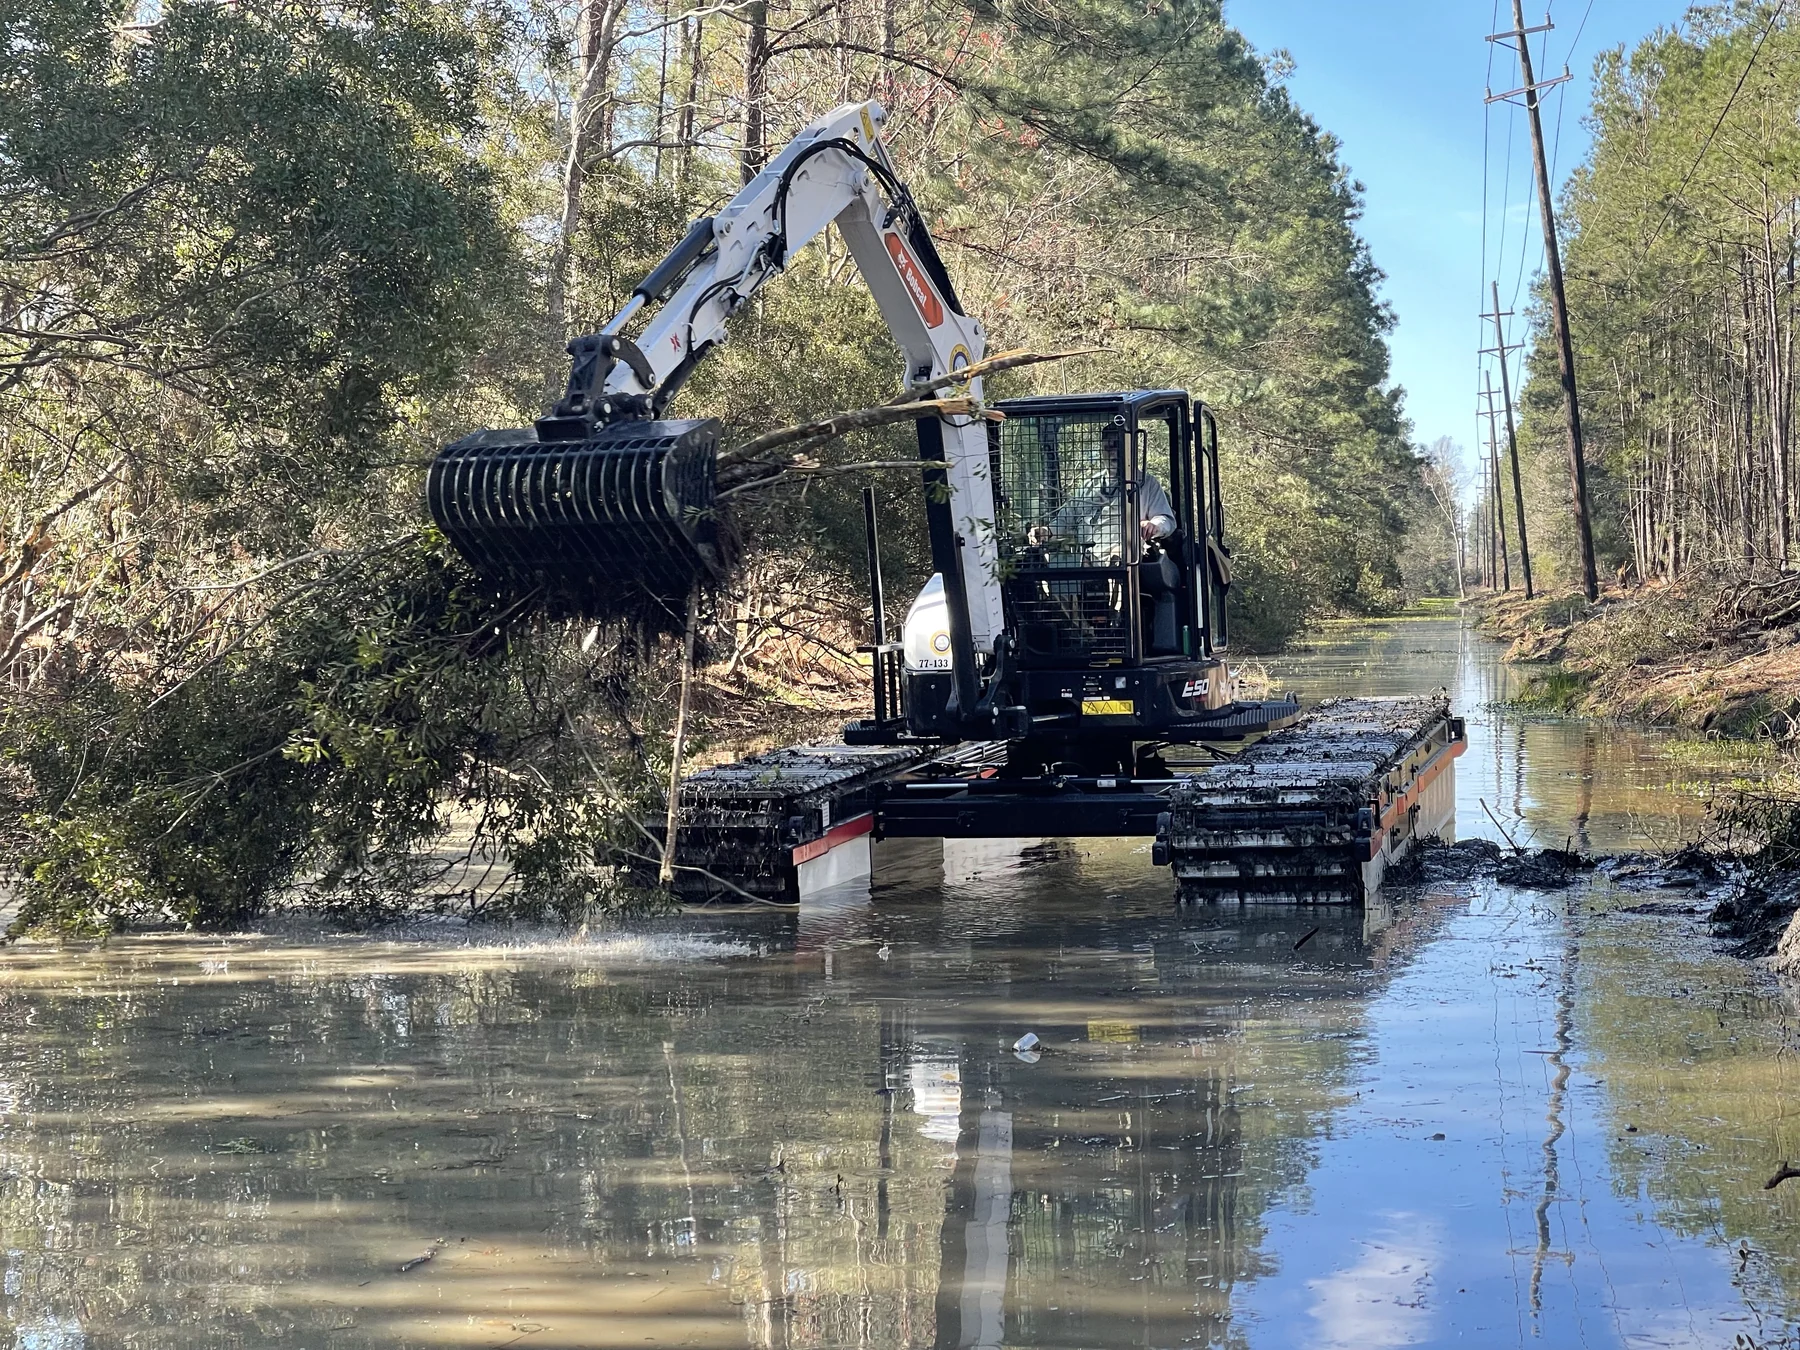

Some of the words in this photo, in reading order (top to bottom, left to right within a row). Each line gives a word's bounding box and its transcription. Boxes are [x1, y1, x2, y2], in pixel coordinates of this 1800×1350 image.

[906, 267, 927, 308] Bobcat
[919, 659, 948, 668] 77-133
[1182, 678, 1209, 697] E50
